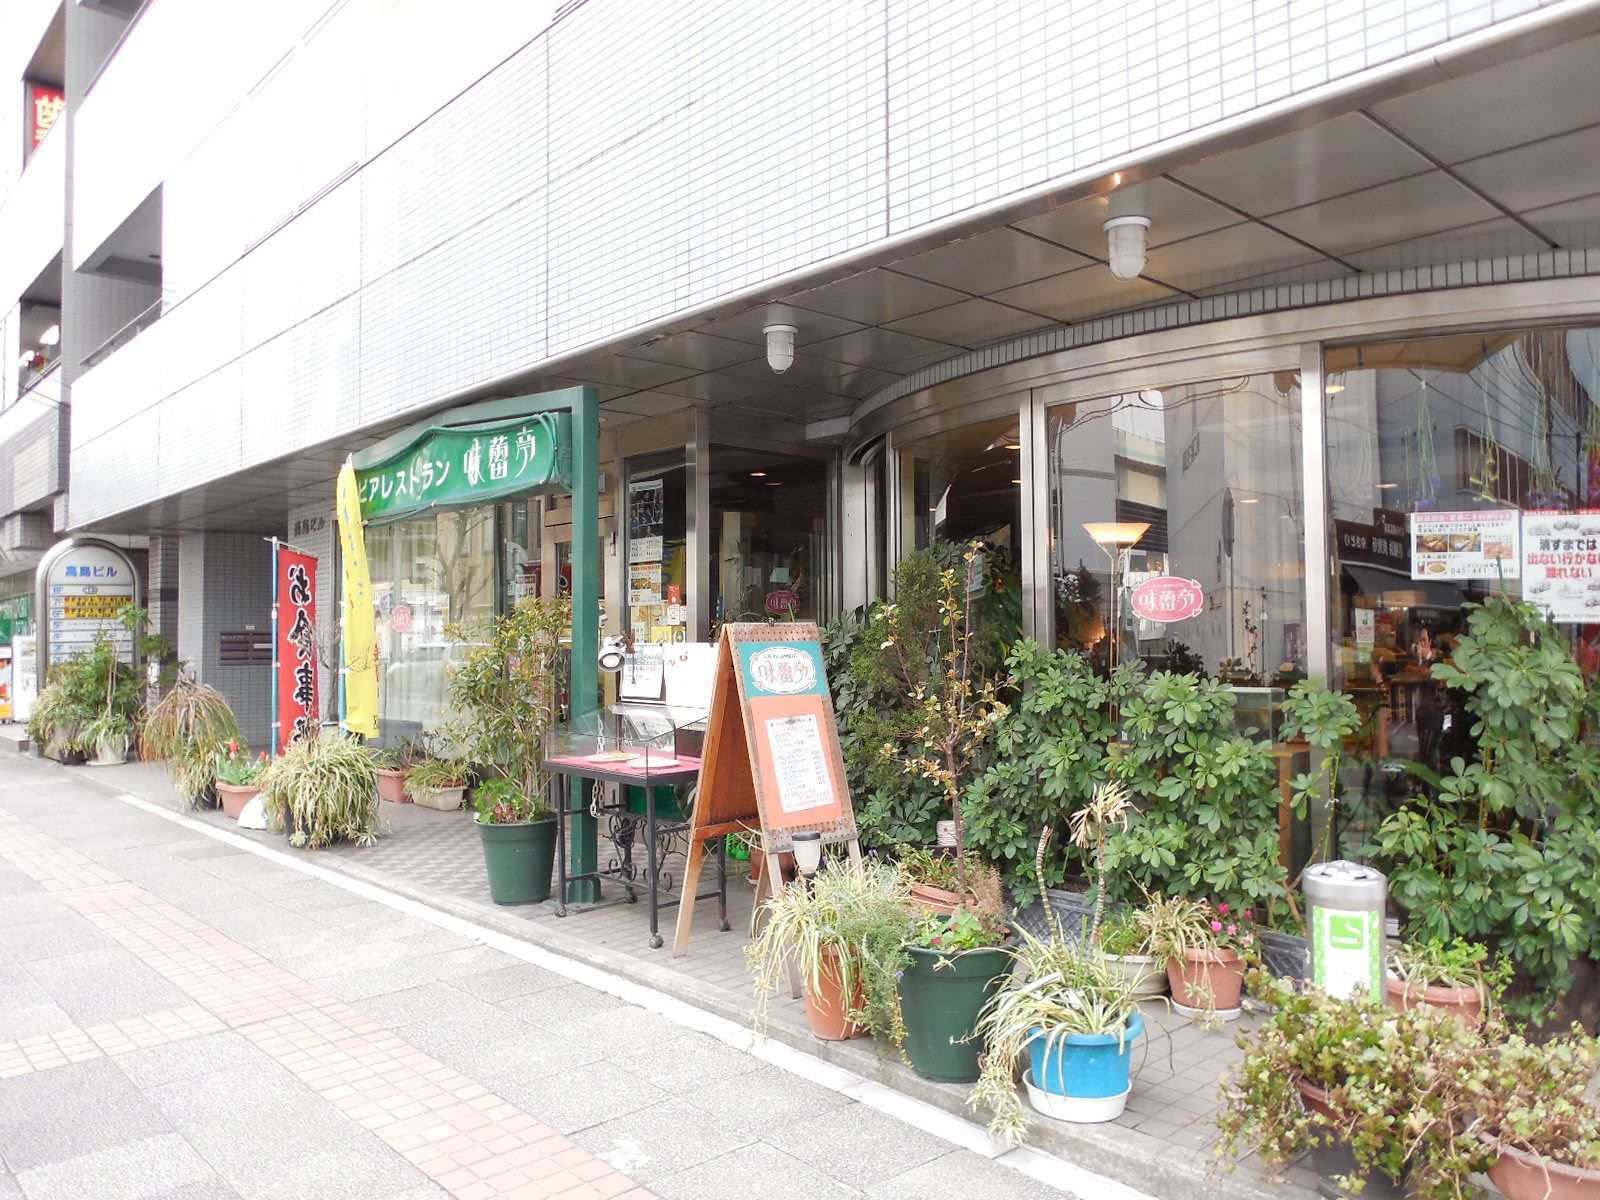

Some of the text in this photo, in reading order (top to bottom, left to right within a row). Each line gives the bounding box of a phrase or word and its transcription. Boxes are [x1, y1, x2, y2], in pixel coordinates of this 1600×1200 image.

[1540, 539, 1597, 551] 消すまでは
[65, 566, 117, 577] 高島ビル
[1545, 567, 1593, 579] 離れない
